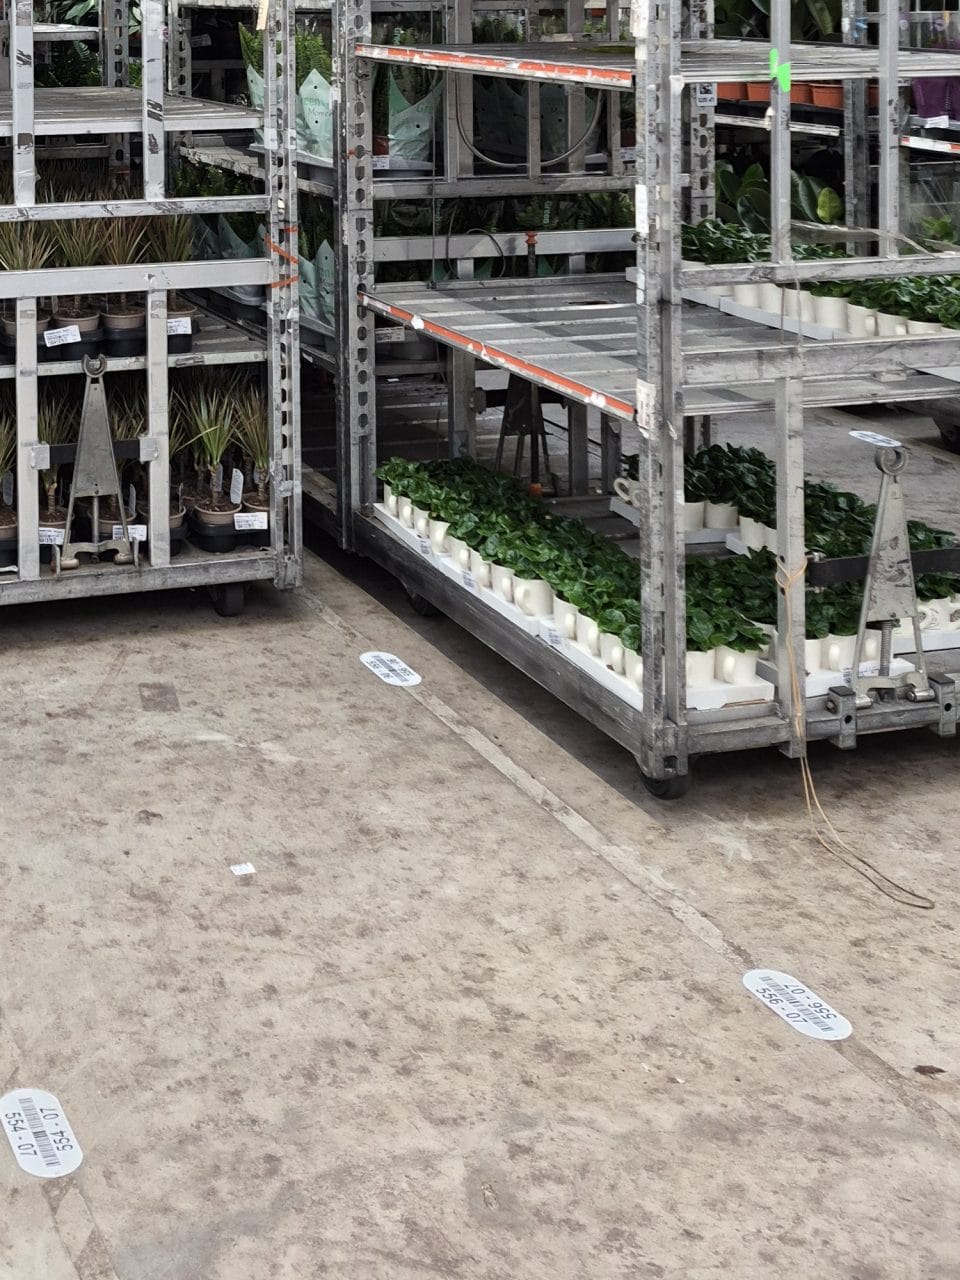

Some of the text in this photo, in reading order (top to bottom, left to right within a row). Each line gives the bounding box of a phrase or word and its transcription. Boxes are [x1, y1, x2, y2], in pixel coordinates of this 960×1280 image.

[543, 200, 553, 224] Green
[784, 984, 806, 995] 07
[756, 987, 784, 1005] 556
[785, 1012, 808, 1023] 07
[807, 1001, 837, 1019] 556
[40, 1108, 59, 1120] 07
[4, 1112, 27, 1132] 554
[17, 1143, 38, 1156] 07
[49, 1130, 74, 1151] 554
